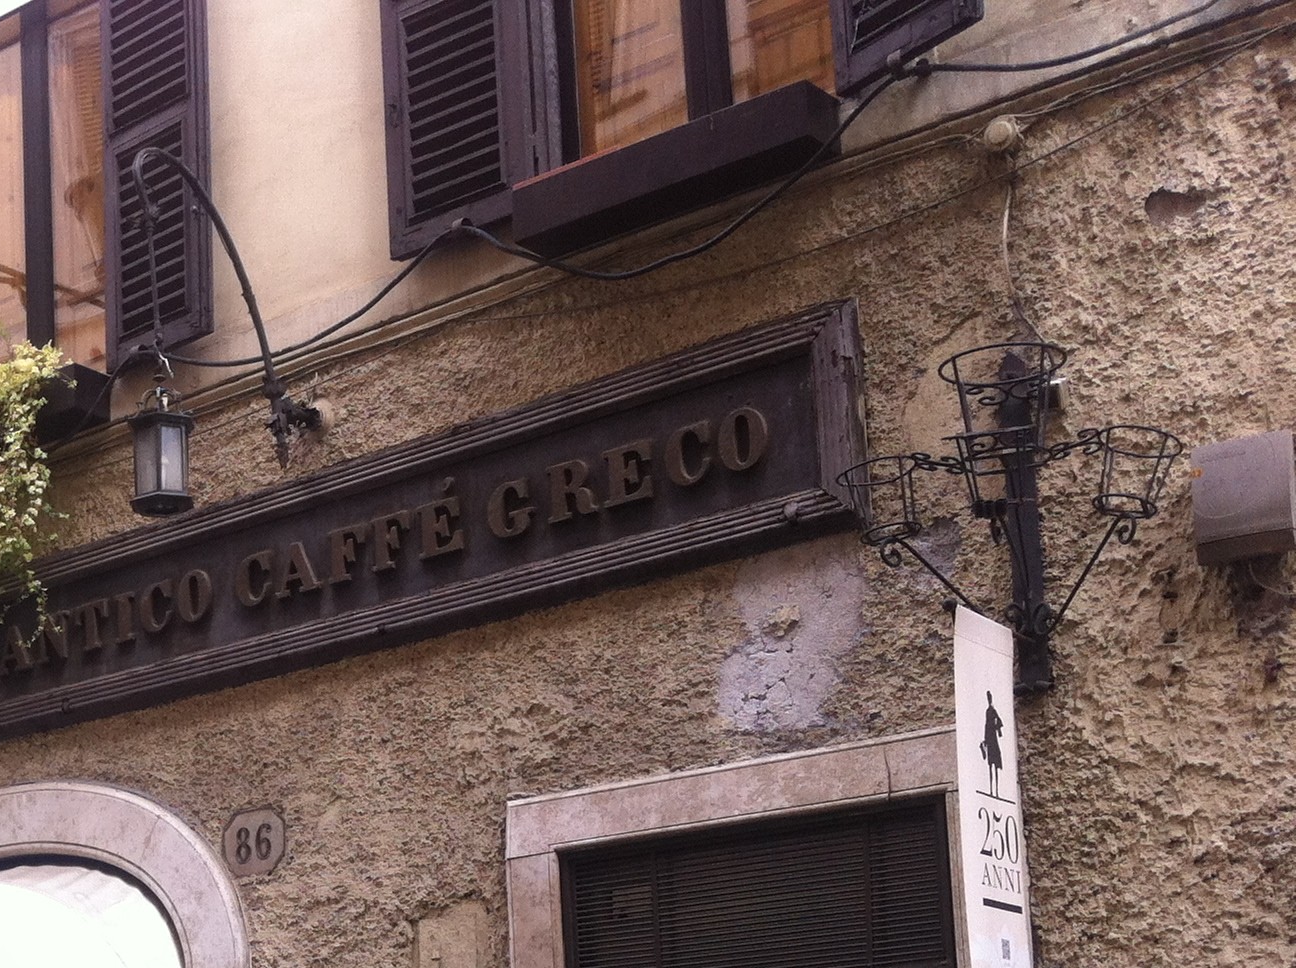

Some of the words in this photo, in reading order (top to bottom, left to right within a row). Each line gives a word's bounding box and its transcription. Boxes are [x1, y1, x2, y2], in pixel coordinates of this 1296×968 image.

[486, 405, 771, 539] GRECO
[235, 822, 273, 865] 86
[977, 806, 1020, 865] 250
[981, 862, 1022, 895] ANNI
